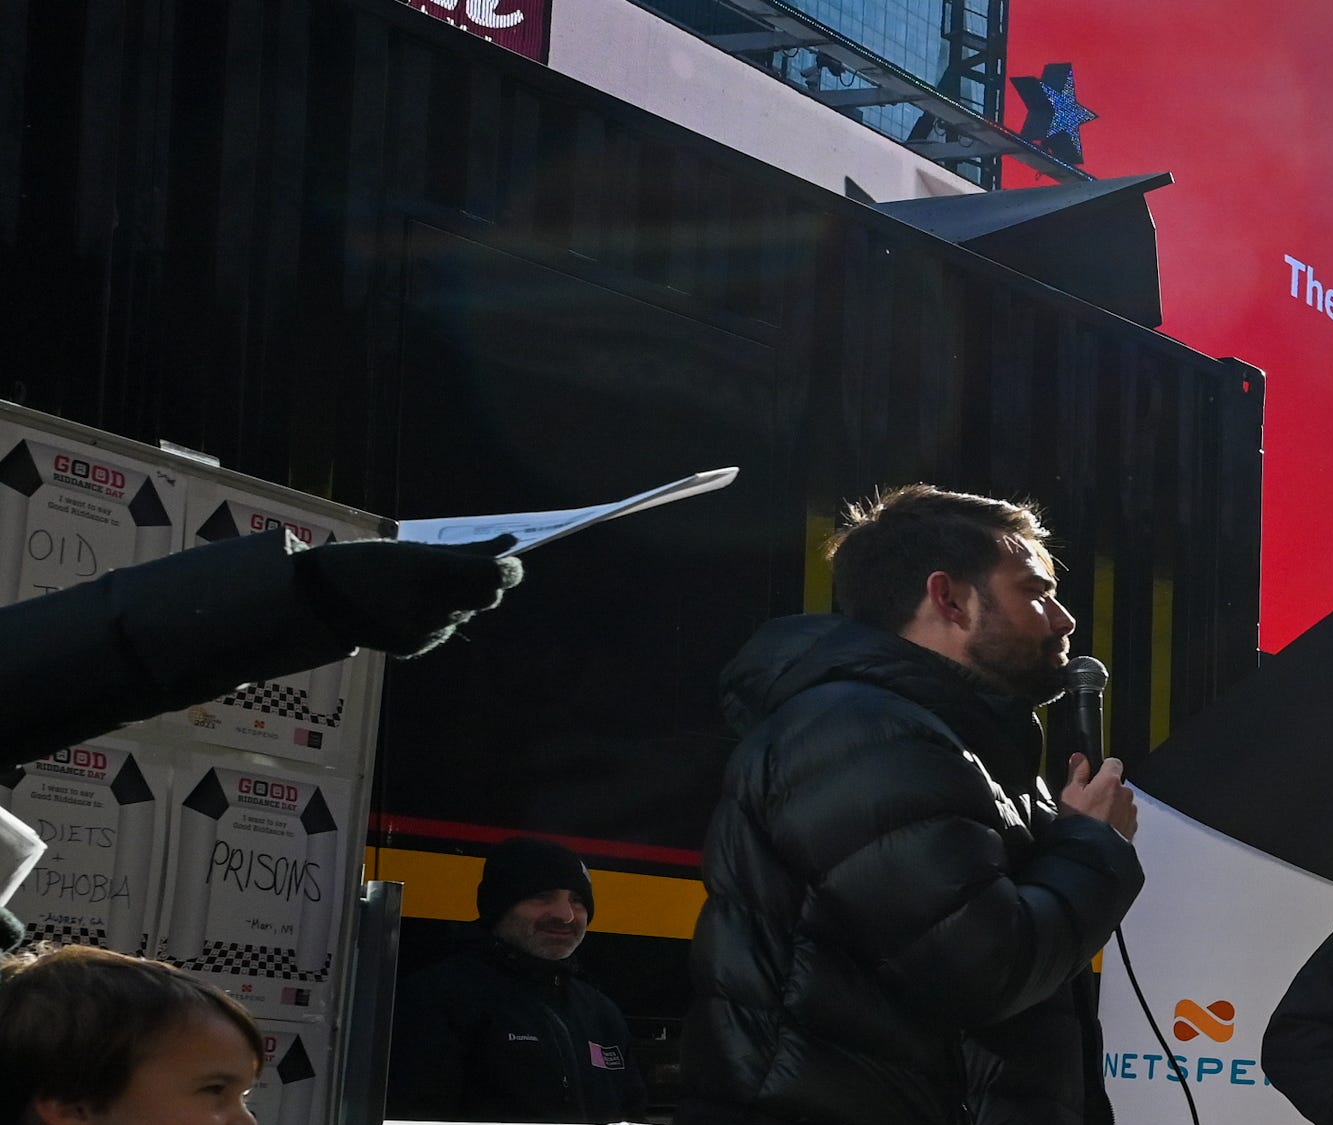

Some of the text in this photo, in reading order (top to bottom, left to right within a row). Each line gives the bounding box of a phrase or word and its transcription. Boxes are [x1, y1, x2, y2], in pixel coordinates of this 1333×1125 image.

[53, 473, 126, 499] RIDDANCE DAY
[54, 455, 126, 489] GOOD
[36, 762, 106, 781] RIDDANCE DAY
[238, 778, 298, 802] GOOD
[238, 795, 297, 811] RIDDANCE DAY
[38, 819, 115, 848] DIETS
[206, 840, 321, 902] PRISONS
[20, 867, 130, 909] TPHOBIA
[1104, 1052, 1271, 1087] NETSPE
